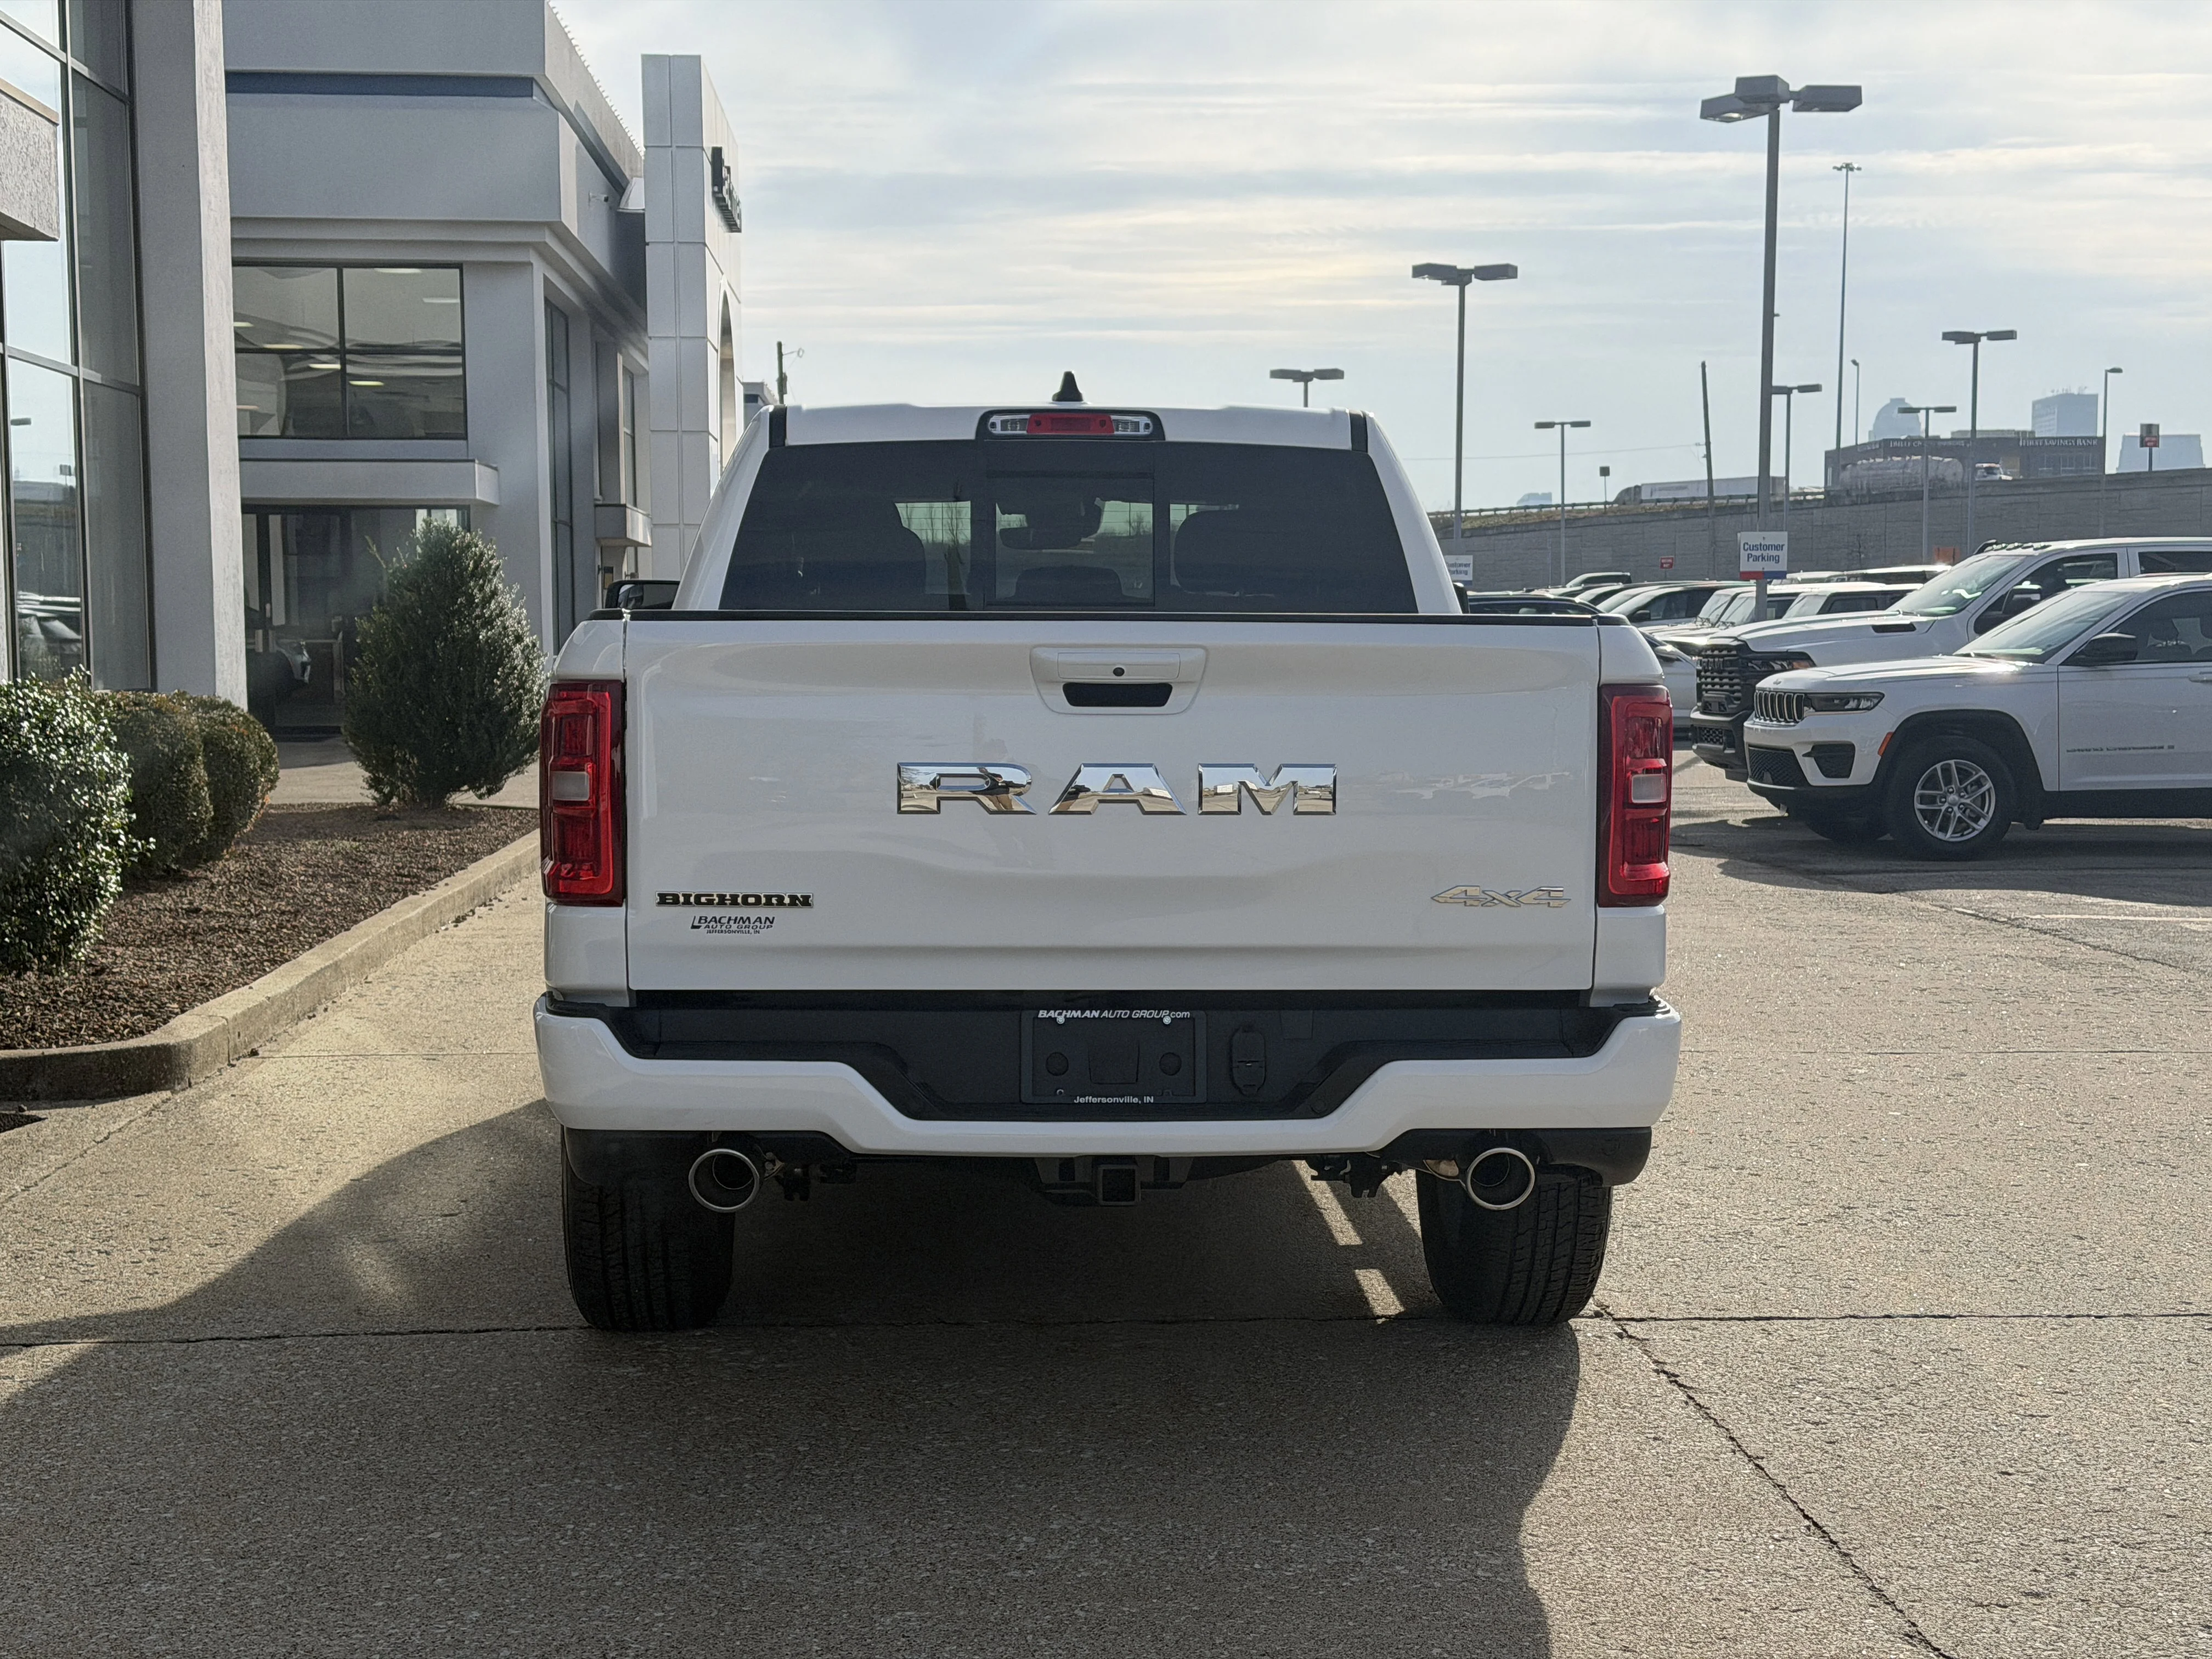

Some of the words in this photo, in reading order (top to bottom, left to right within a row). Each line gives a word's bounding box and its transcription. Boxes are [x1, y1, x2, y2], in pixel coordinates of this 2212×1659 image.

[2076, 438, 2098, 447] BANK
[1743, 542, 1785, 551] Customer
[1747, 553, 1780, 564] Parking
[897, 761, 1337, 815] RAM
[656, 891, 814, 908] BIGHORN
[697, 916, 775, 924] BACHMAN
[1037, 1010, 1100, 1018] BACHMAN
[1101, 1010, 1130, 1018] AUTO
[1131, 1010, 1190, 1018] GROUPcom
